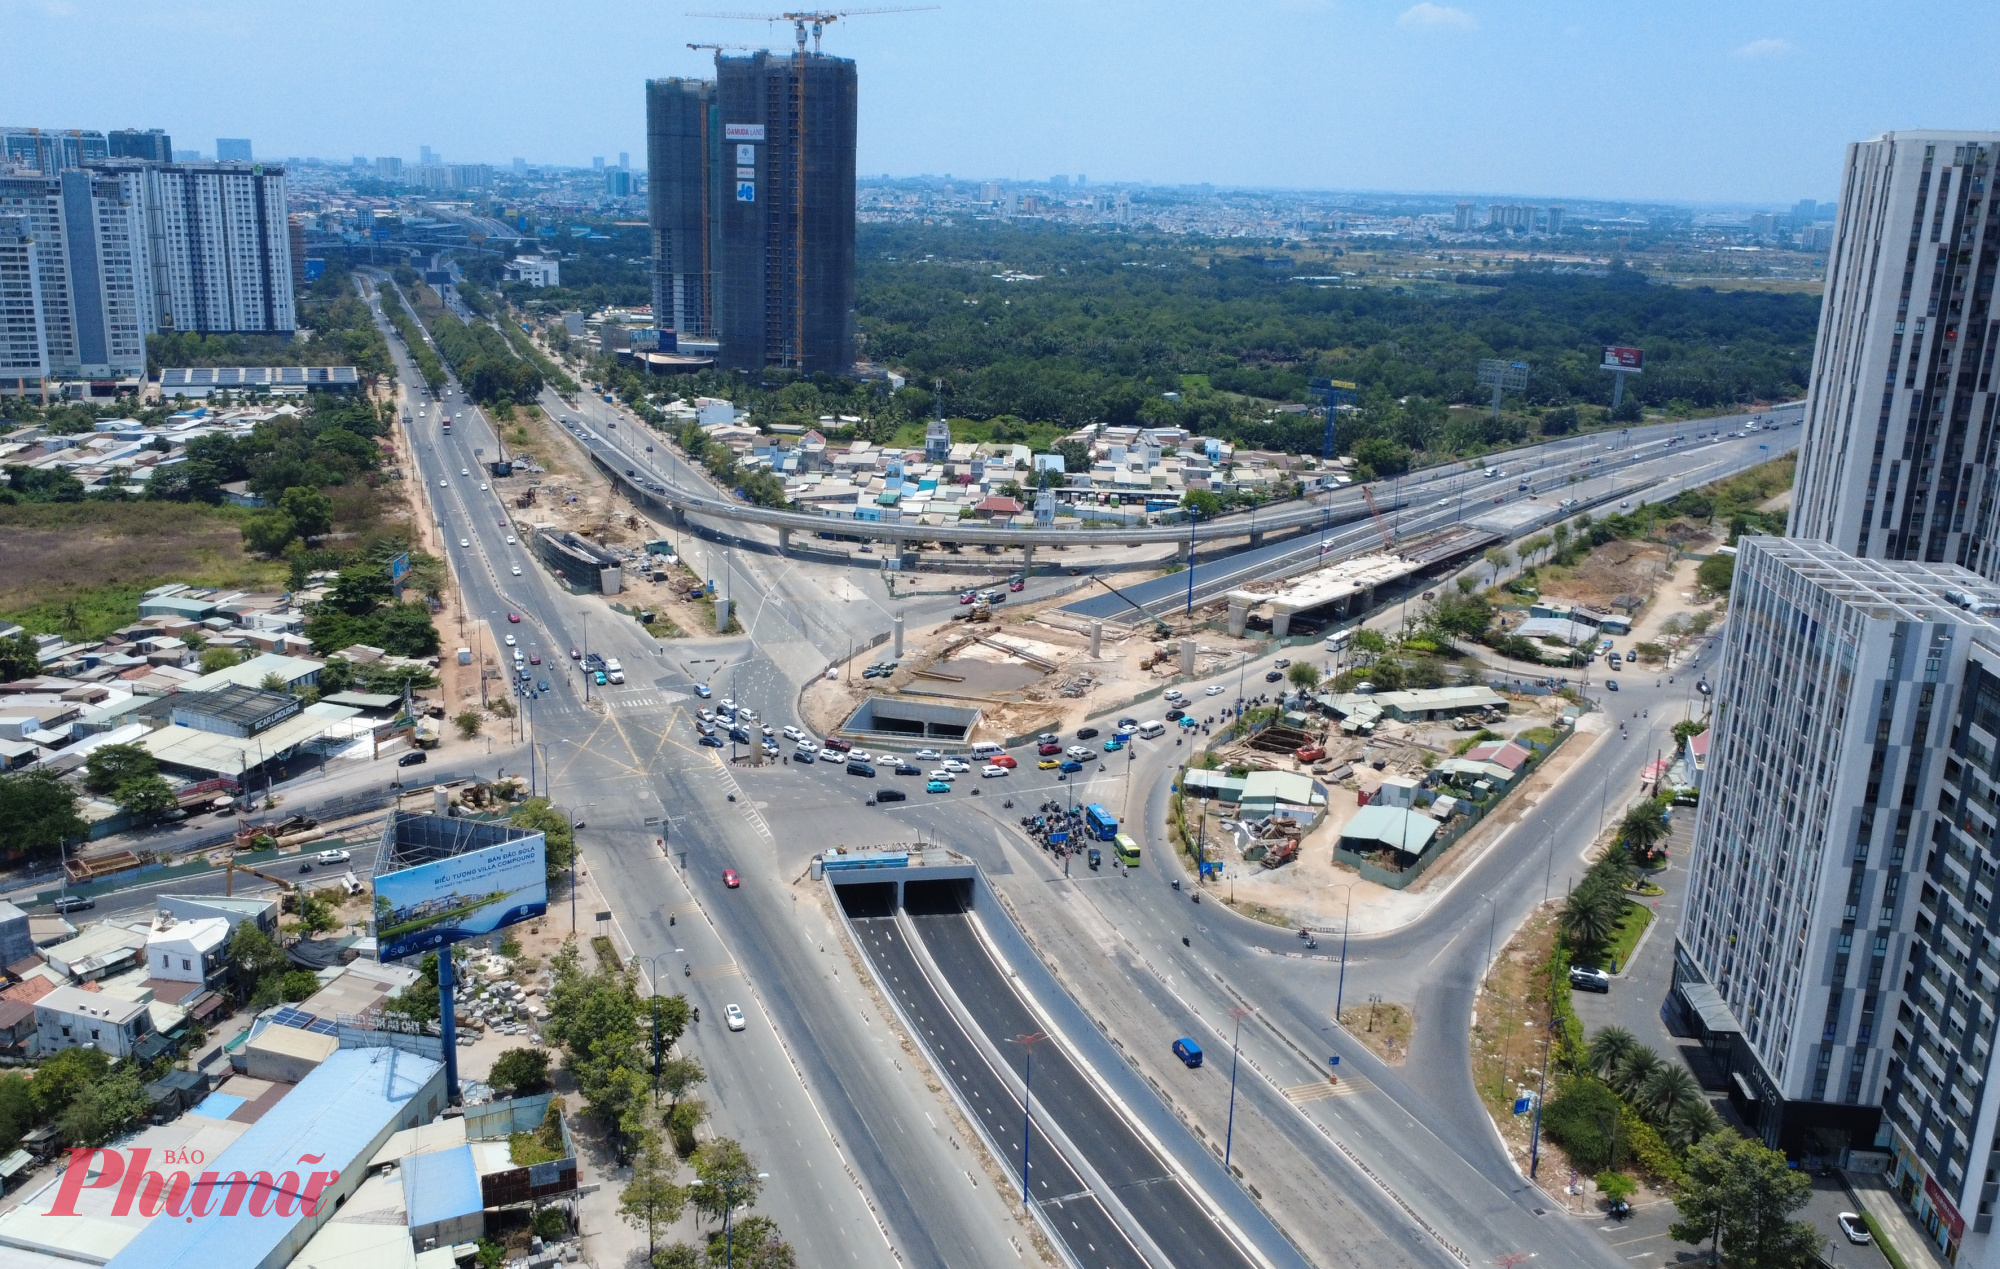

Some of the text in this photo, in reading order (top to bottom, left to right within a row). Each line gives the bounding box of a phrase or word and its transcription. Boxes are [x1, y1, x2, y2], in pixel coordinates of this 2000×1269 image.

[727, 128, 749, 136] GAMUDA
[271, 702, 299, 722] LIMOUSINE
[478, 863, 496, 872] VILLA
[497, 852, 536, 868] COMPOUND
